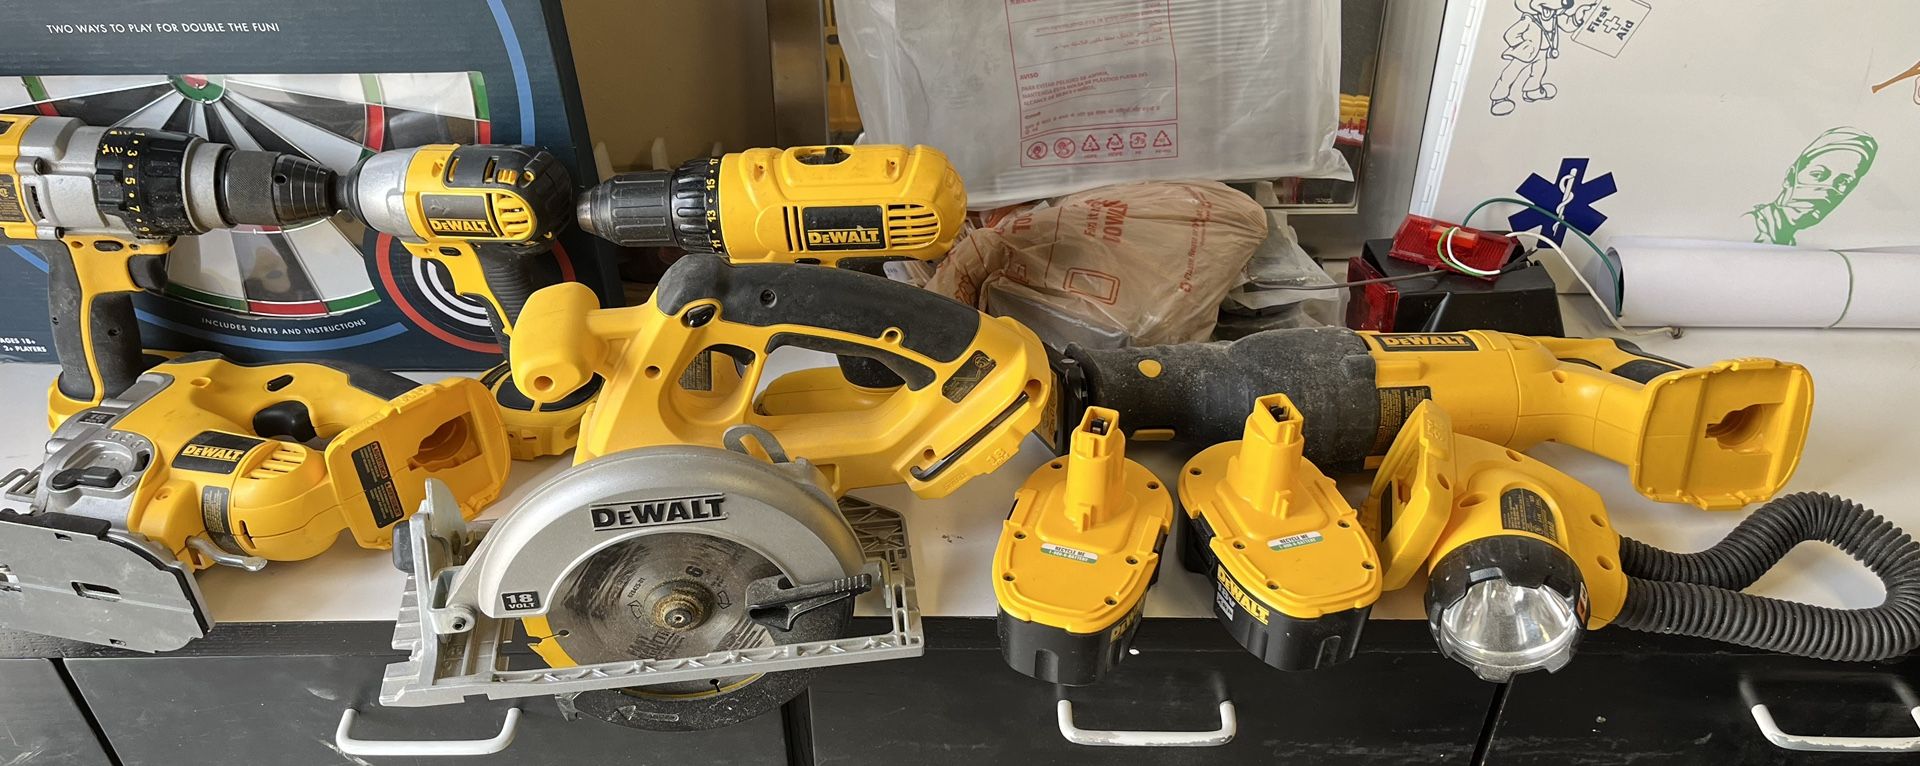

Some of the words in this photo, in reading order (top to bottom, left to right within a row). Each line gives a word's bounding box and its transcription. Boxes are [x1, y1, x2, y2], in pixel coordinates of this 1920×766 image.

[1587, 6, 1611, 33] First
[1616, 20, 1634, 40] Aid
[47, 24, 73, 34] TWO
[76, 24, 107, 33] WAYS
[110, 24, 125, 33] TO
[128, 24, 152, 33] PLAY
[156, 24, 179, 33] FOR
[182, 23, 225, 32] DOUBLE
[227, 23, 249, 32] THE
[252, 22, 280, 32] FUN!
[1020, 72, 1039, 80] AVISO
[125, 177, 136, 185] 5
[706, 178, 716, 190] 15
[129, 205, 141, 213] 7
[706, 210, 716, 222] 13
[711, 239, 721, 248] 11
[202, 317, 247, 331] INCLUDES
[250, 326, 278, 335] DARTS
[282, 327, 301, 335] AND
[304, 319, 367, 335] INSTRUCTIONS
[0, 338, 20, 346] AGES
[20, 338, 36, 346] 18+
[15, 345, 47, 353] PLAYERS
[1055, 546, 1076, 555] RECYCLE
[506, 593, 534, 603] 18
[508, 602, 536, 610] VOLT
